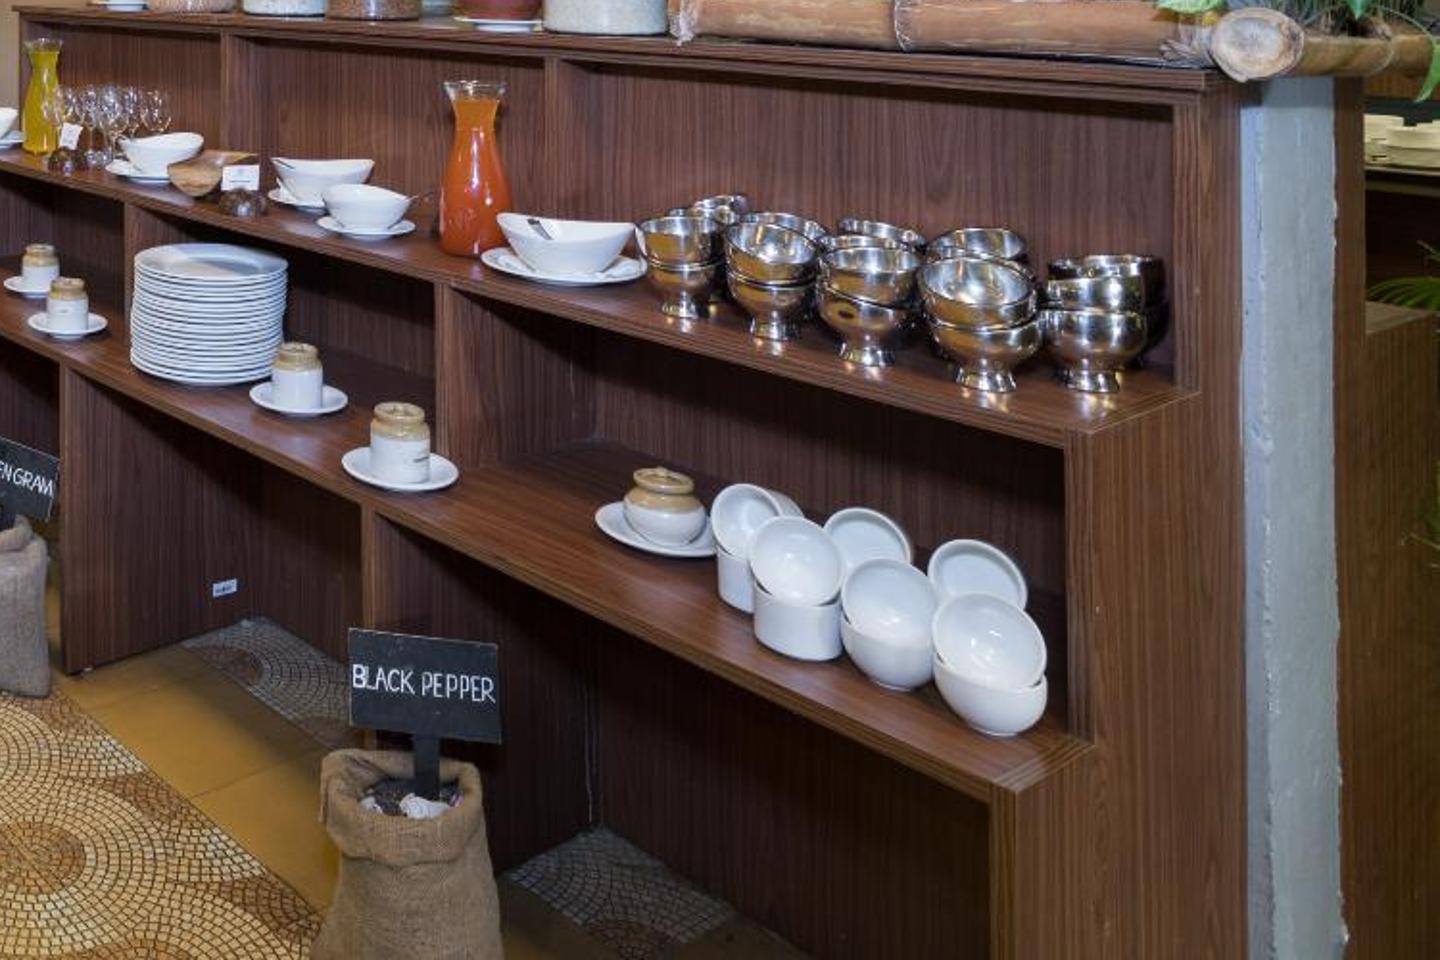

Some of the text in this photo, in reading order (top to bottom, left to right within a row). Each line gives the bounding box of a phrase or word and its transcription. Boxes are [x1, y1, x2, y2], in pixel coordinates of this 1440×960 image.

[13, 468, 54, 497] GRAM
[352, 663, 497, 704] BLACK PEPPER
